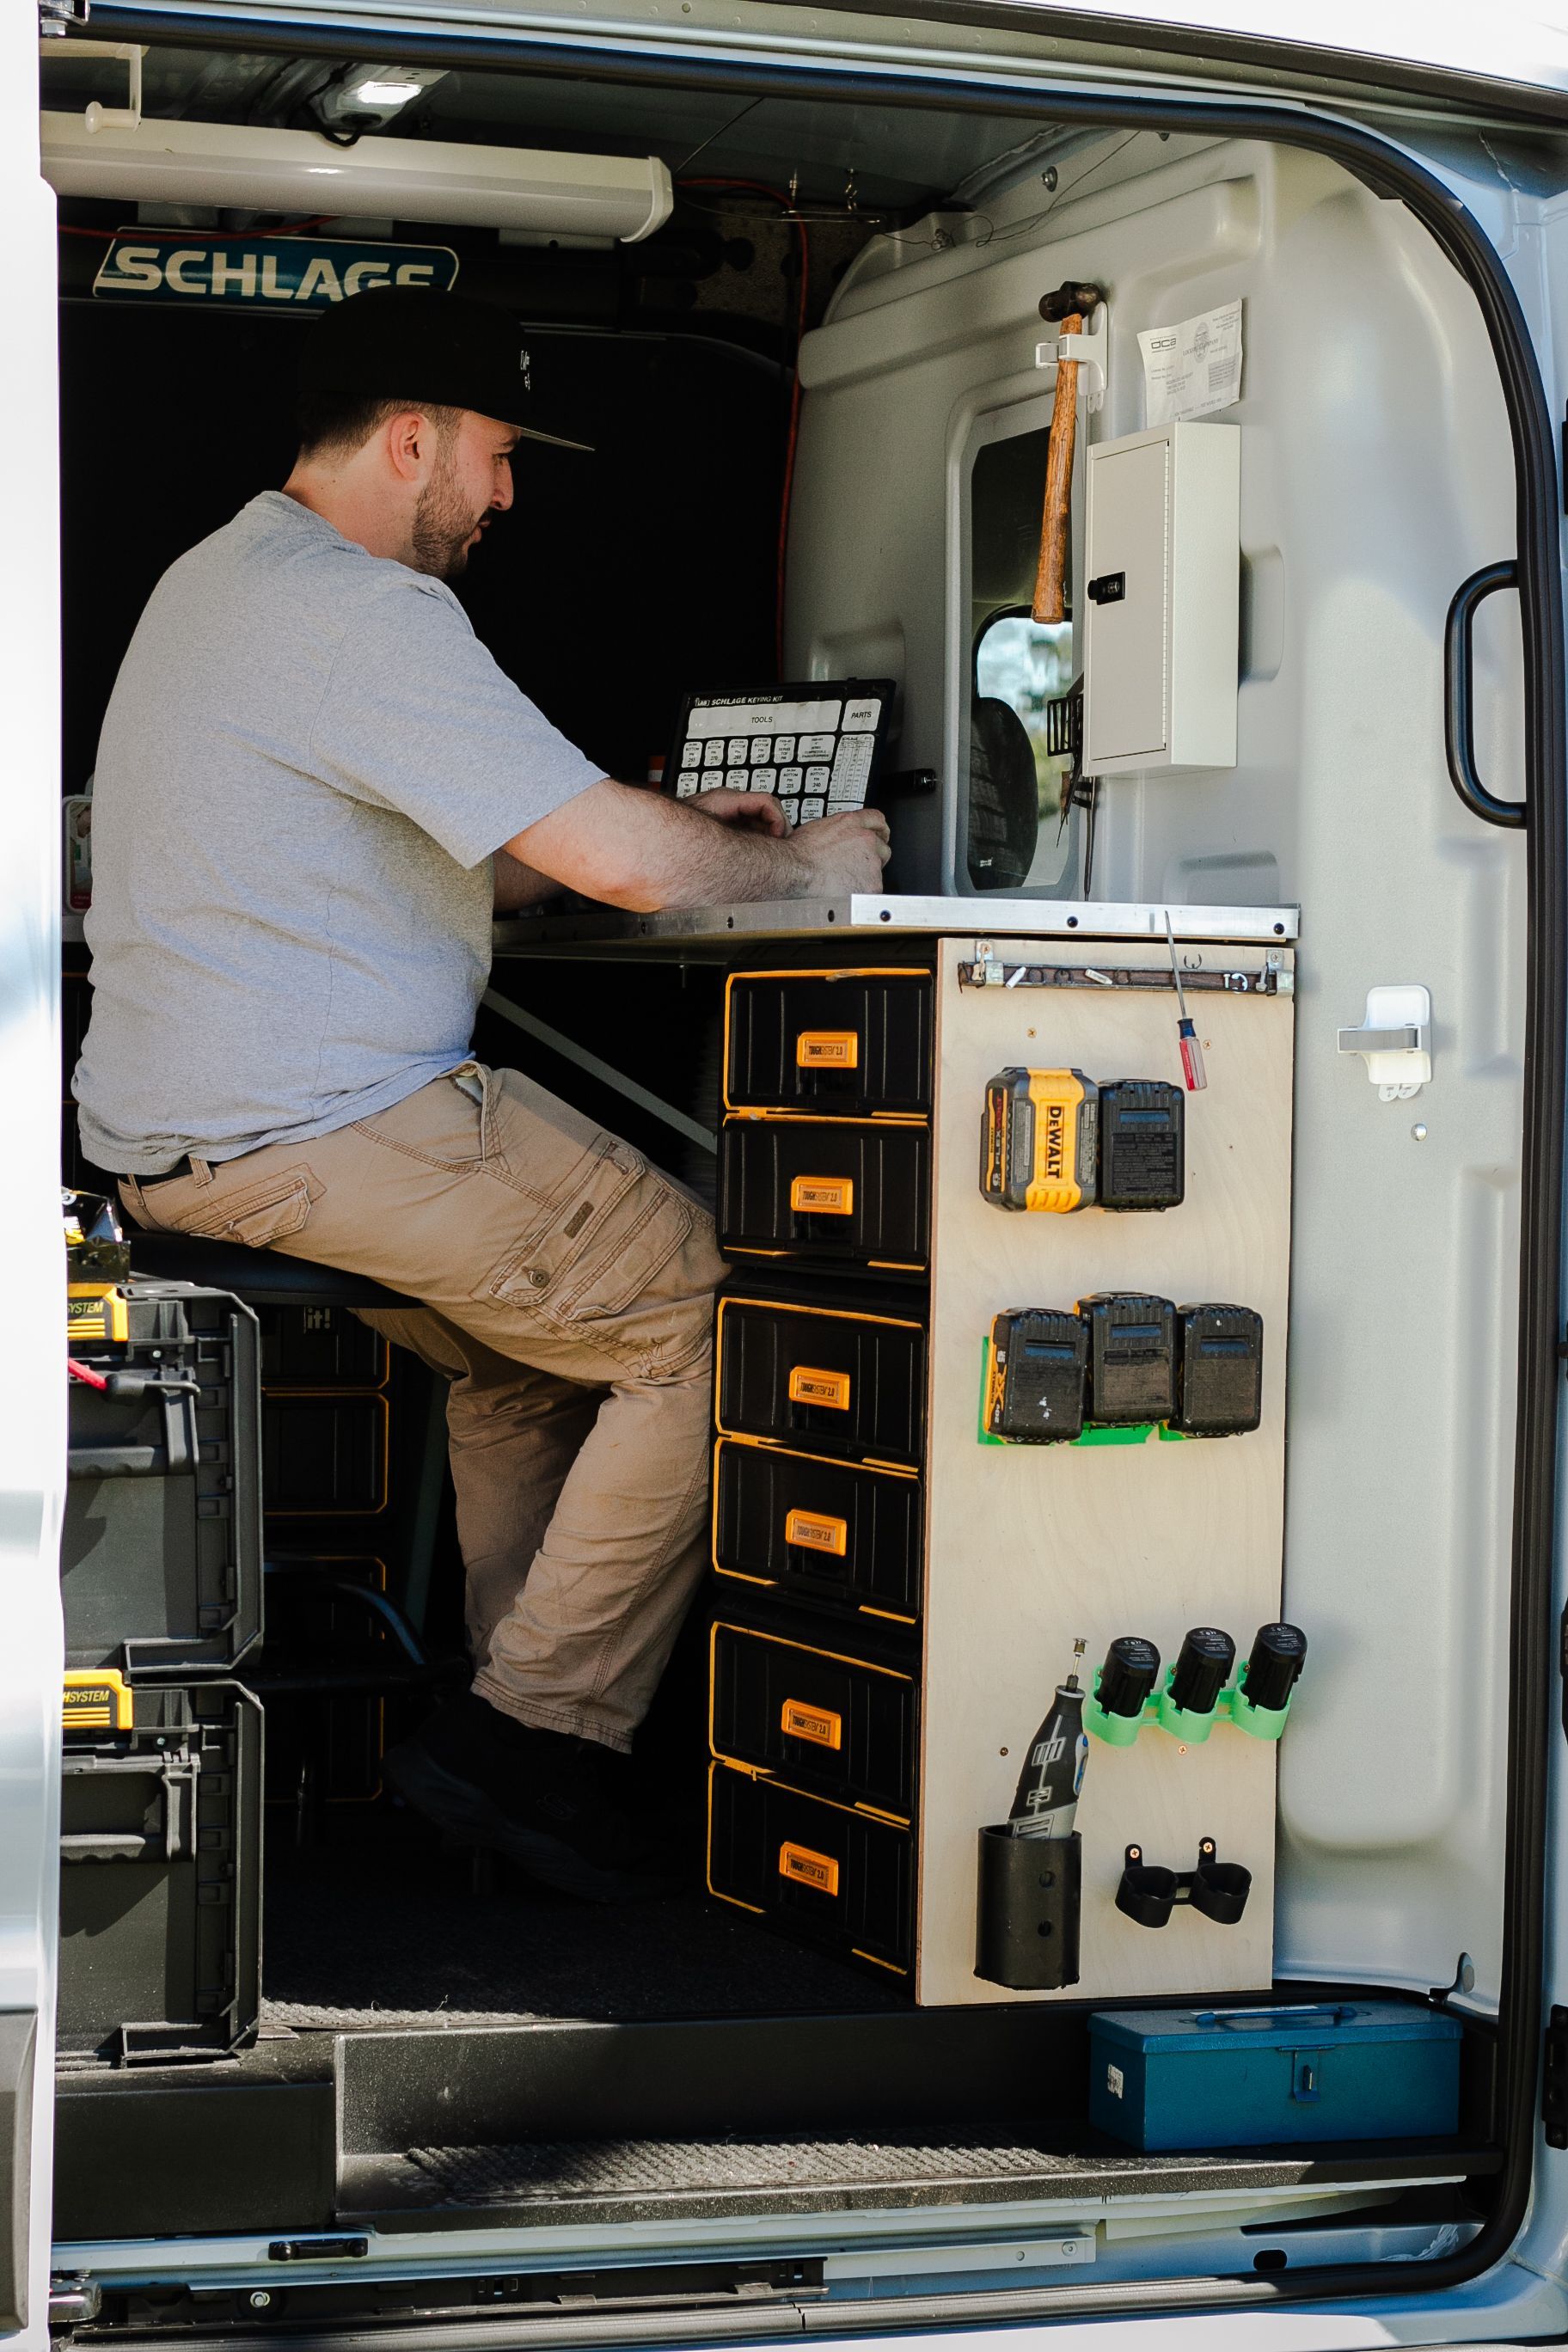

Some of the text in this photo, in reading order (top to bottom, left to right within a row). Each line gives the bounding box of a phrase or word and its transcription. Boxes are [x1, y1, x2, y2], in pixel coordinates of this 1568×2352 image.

[711, 696, 747, 706] SCHLAGE
[747, 695, 772, 704] KEYING
[772, 695, 784, 703] KIT
[850, 711, 872, 720] PARTS
